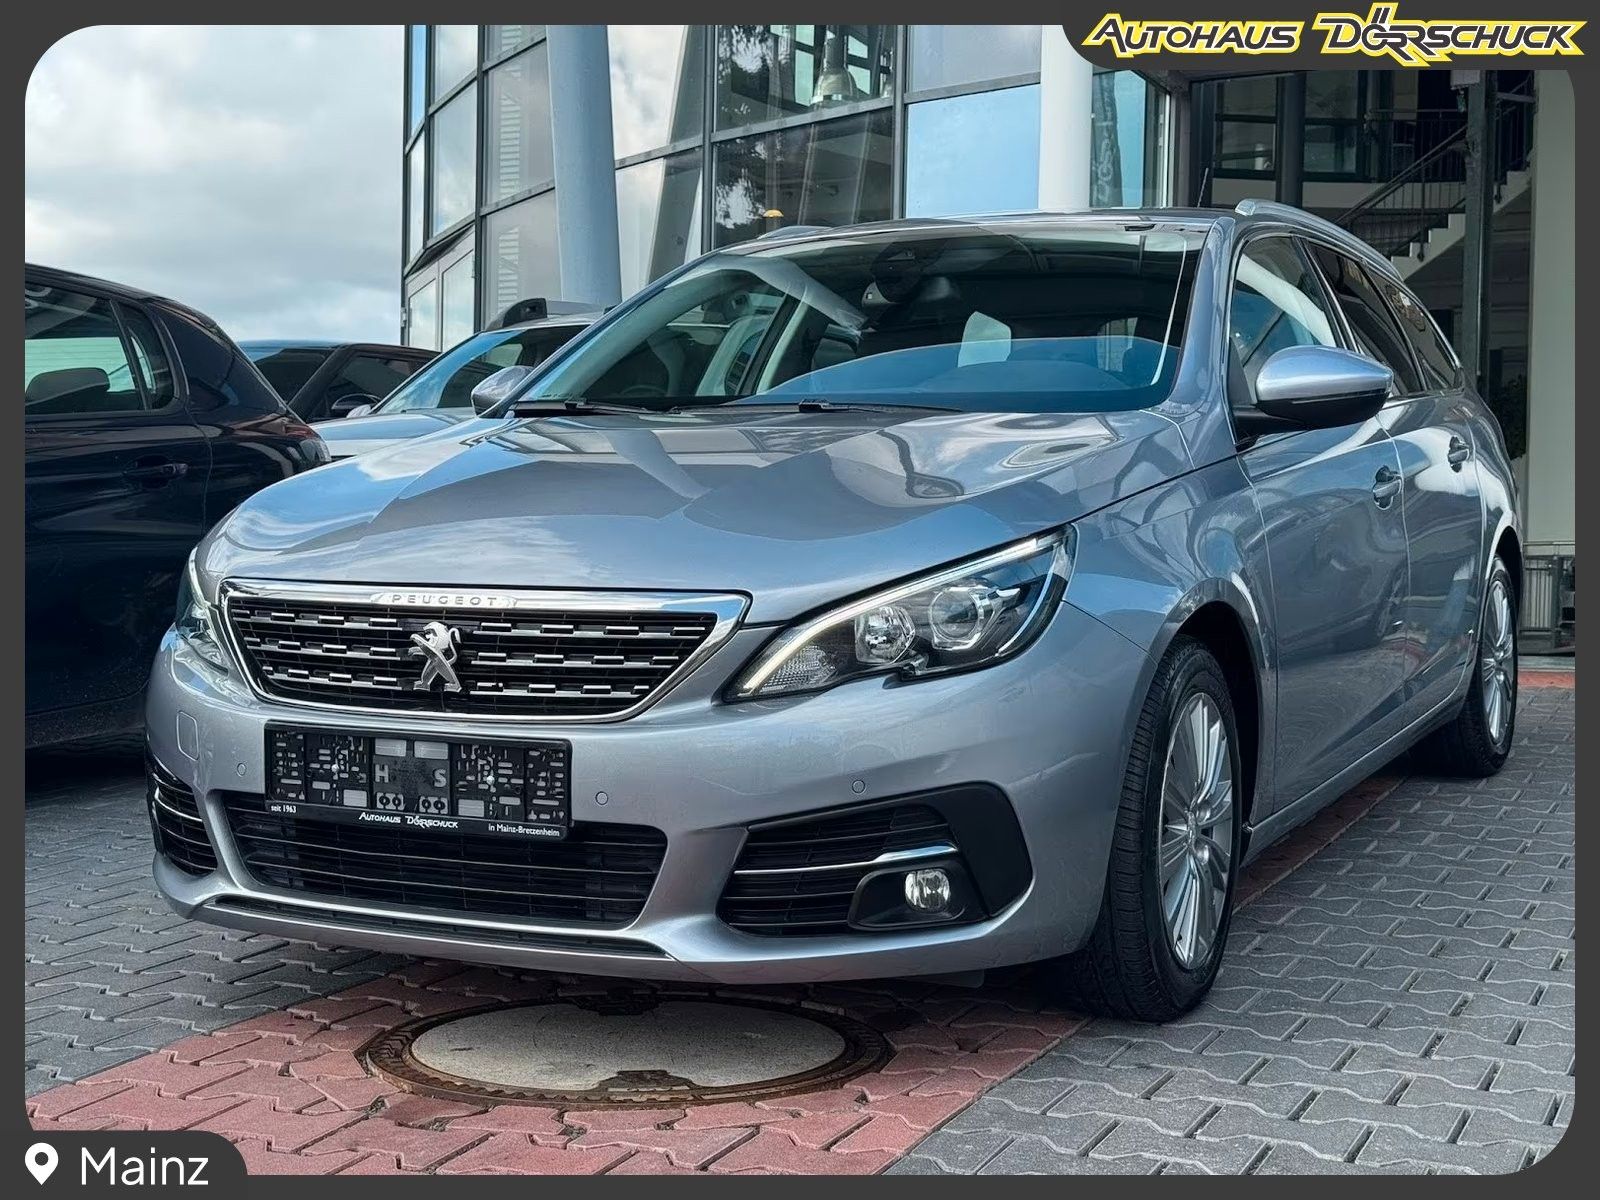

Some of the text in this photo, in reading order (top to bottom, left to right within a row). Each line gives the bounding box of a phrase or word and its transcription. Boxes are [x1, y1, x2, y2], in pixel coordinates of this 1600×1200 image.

[391, 594, 497, 606] PEUGEOT
[283, 804, 297, 814] 1963
[359, 812, 401, 824] AUTOHAUS
